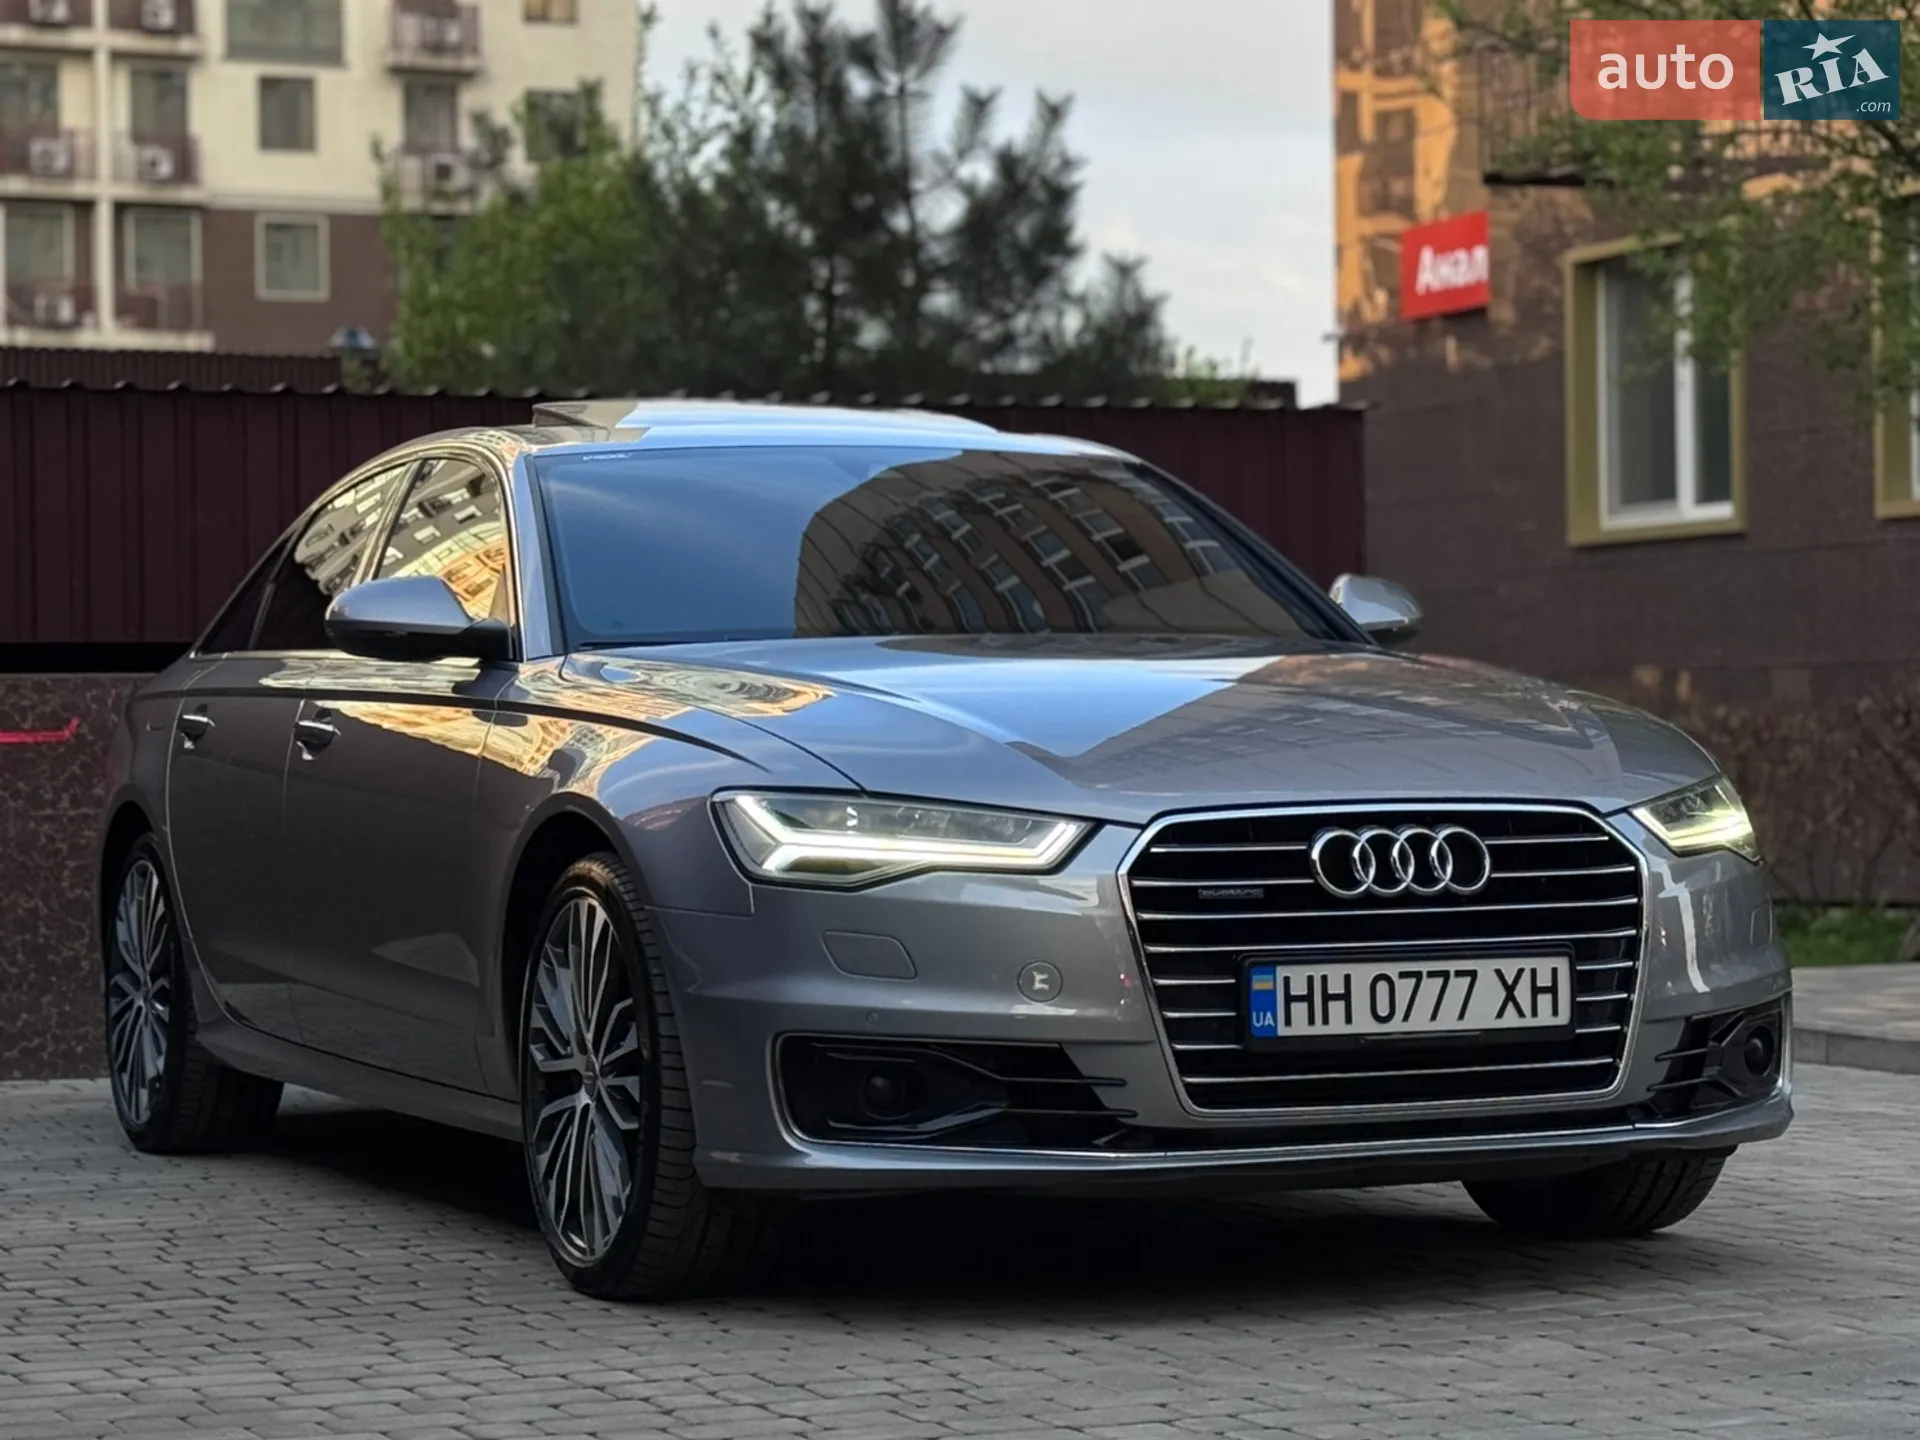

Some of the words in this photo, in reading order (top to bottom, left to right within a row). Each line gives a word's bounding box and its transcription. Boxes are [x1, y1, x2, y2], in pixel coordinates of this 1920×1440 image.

[1282, 973, 1353, 1027] HH
[1369, 968, 1478, 1024] 0777
[1493, 966, 1559, 1020] XH
[1252, 1012, 1276, 1027] UA
